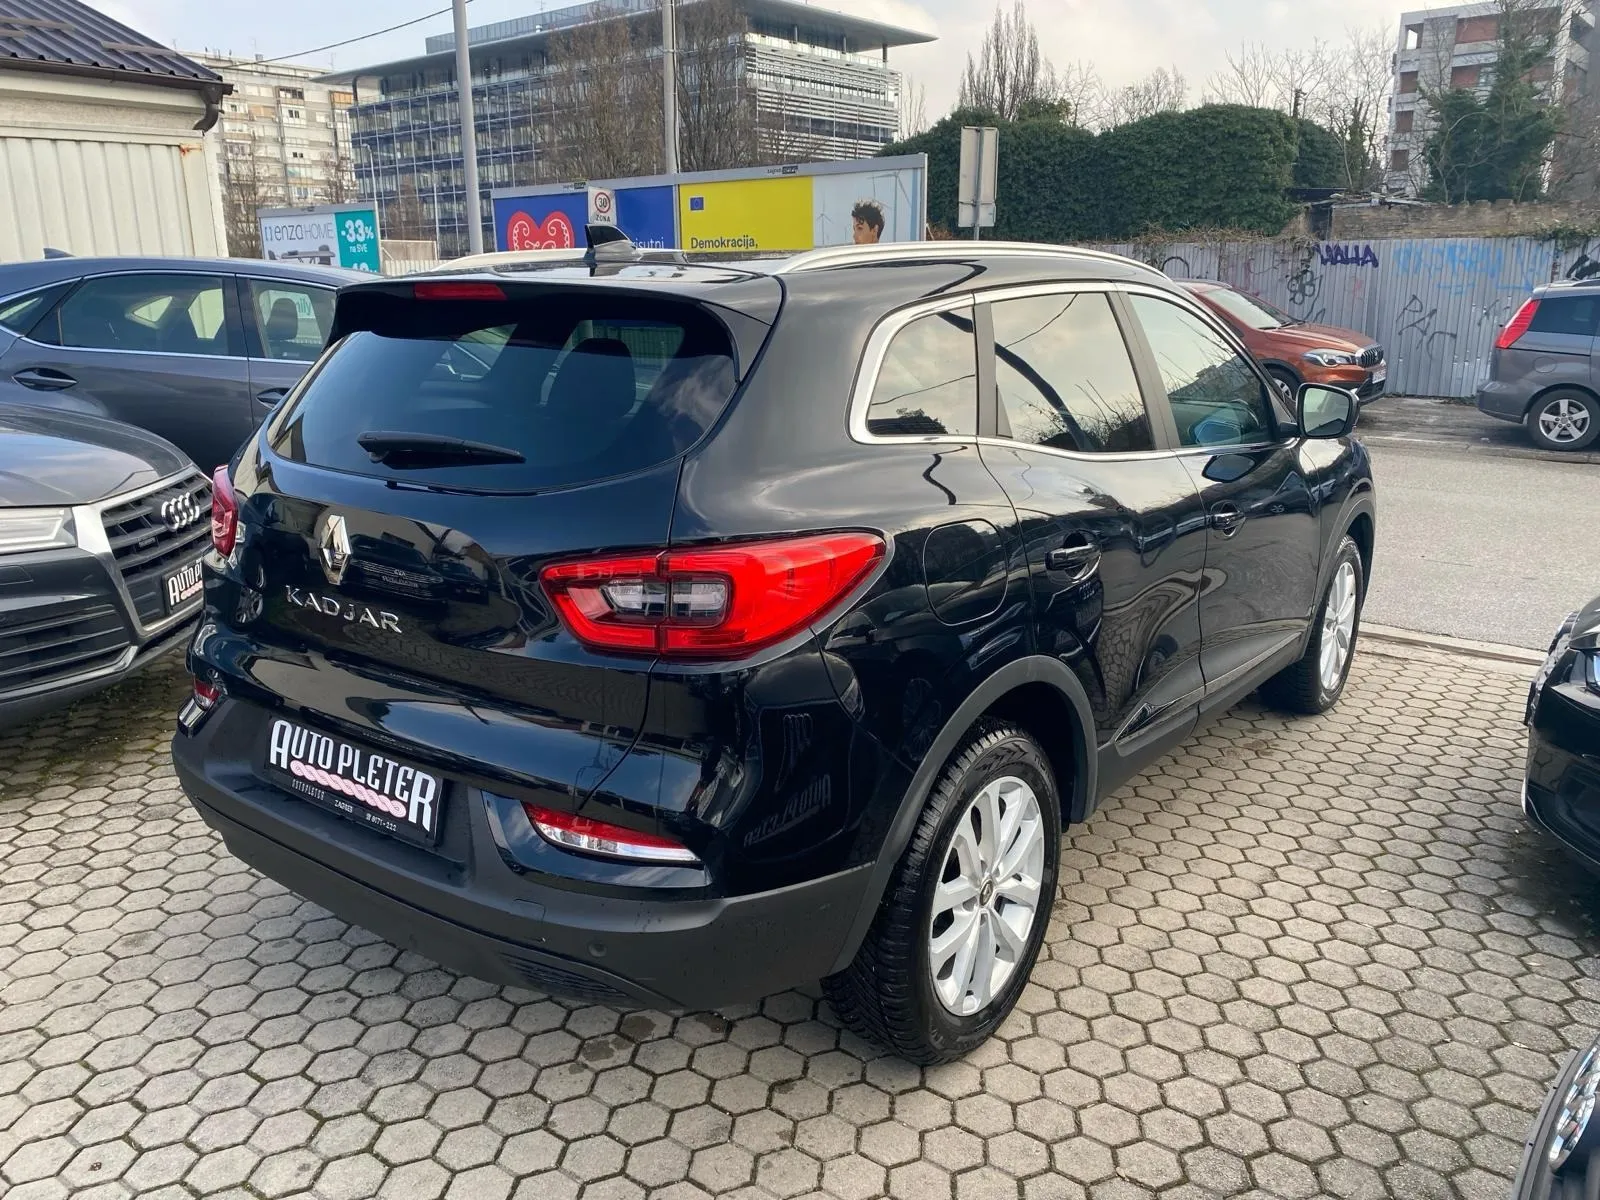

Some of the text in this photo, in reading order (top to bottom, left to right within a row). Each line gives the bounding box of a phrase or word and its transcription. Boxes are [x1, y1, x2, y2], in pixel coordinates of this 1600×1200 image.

[598, 198, 608, 208] 30
[595, 214, 611, 222] ZONA
[690, 234, 759, 249] Demokracija,
[168, 566, 195, 605] AUTO
[285, 584, 402, 633] KADJAR
[270, 719, 437, 832] AUTO PLETER
[334, 799, 353, 813] ZAGREB
